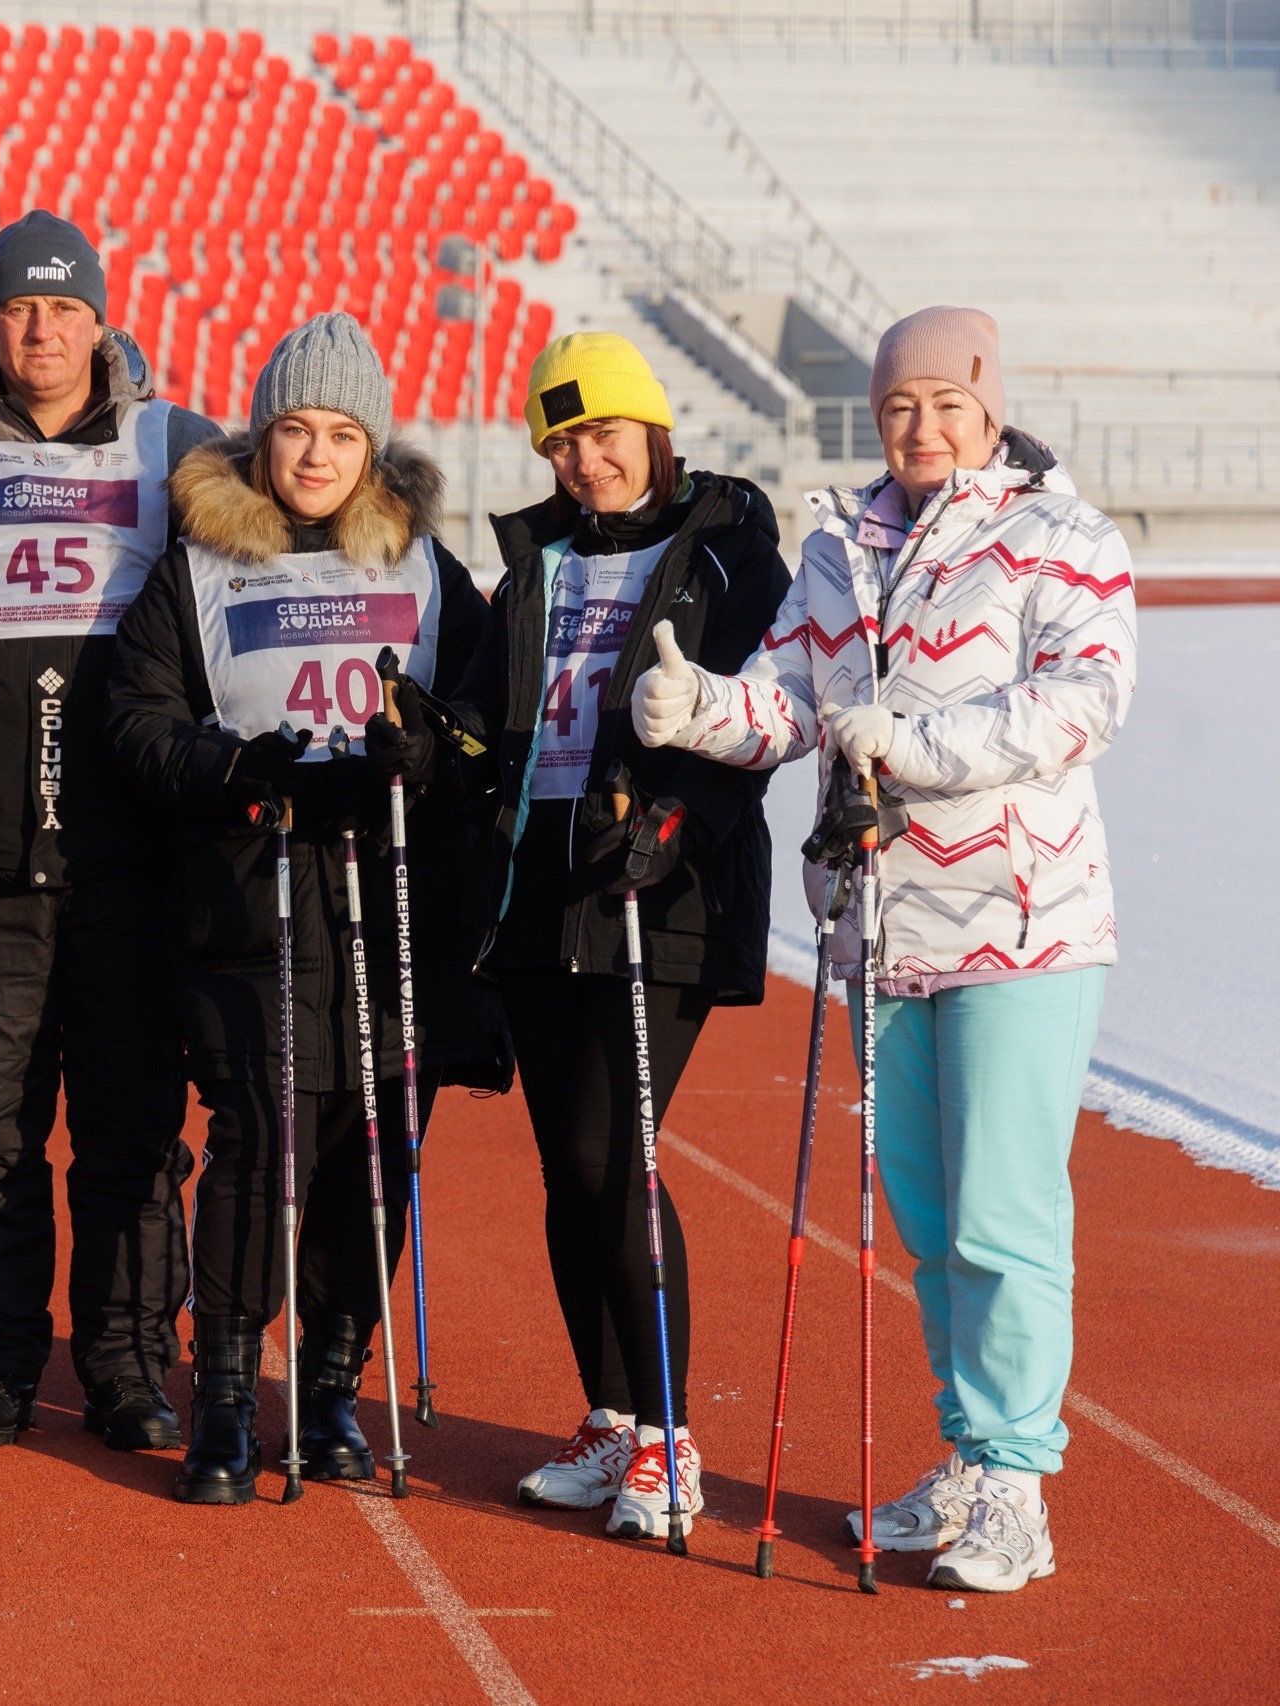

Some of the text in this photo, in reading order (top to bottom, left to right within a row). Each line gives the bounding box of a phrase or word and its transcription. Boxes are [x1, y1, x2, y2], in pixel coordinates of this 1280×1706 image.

[27, 266, 65, 281] PUMA
[1, 508, 89, 517] НОВЫЙ ОБРАЗ ЖИЗНИ
[4, 482, 89, 499] СЕВЕРНАЯ
[6, 537, 95, 594] 45
[276, 600, 367, 616] СЕВЕРНАЯ
[280, 629, 371, 640] НОВЫЙ ОБРАЗ ЖИЗНИ
[285, 657, 380, 725] 40
[542, 667, 612, 737] 41
[40, 699, 63, 829] COLUMBIA
[395, 864, 411, 963] СЕВЕРНАЯ
[352, 938, 371, 1034] СЕВЕРНАЯ
[863, 958, 875, 1061] СЕВЕРНАЯ
[631, 981, 651, 1082] СЕВЕРНАЯ
